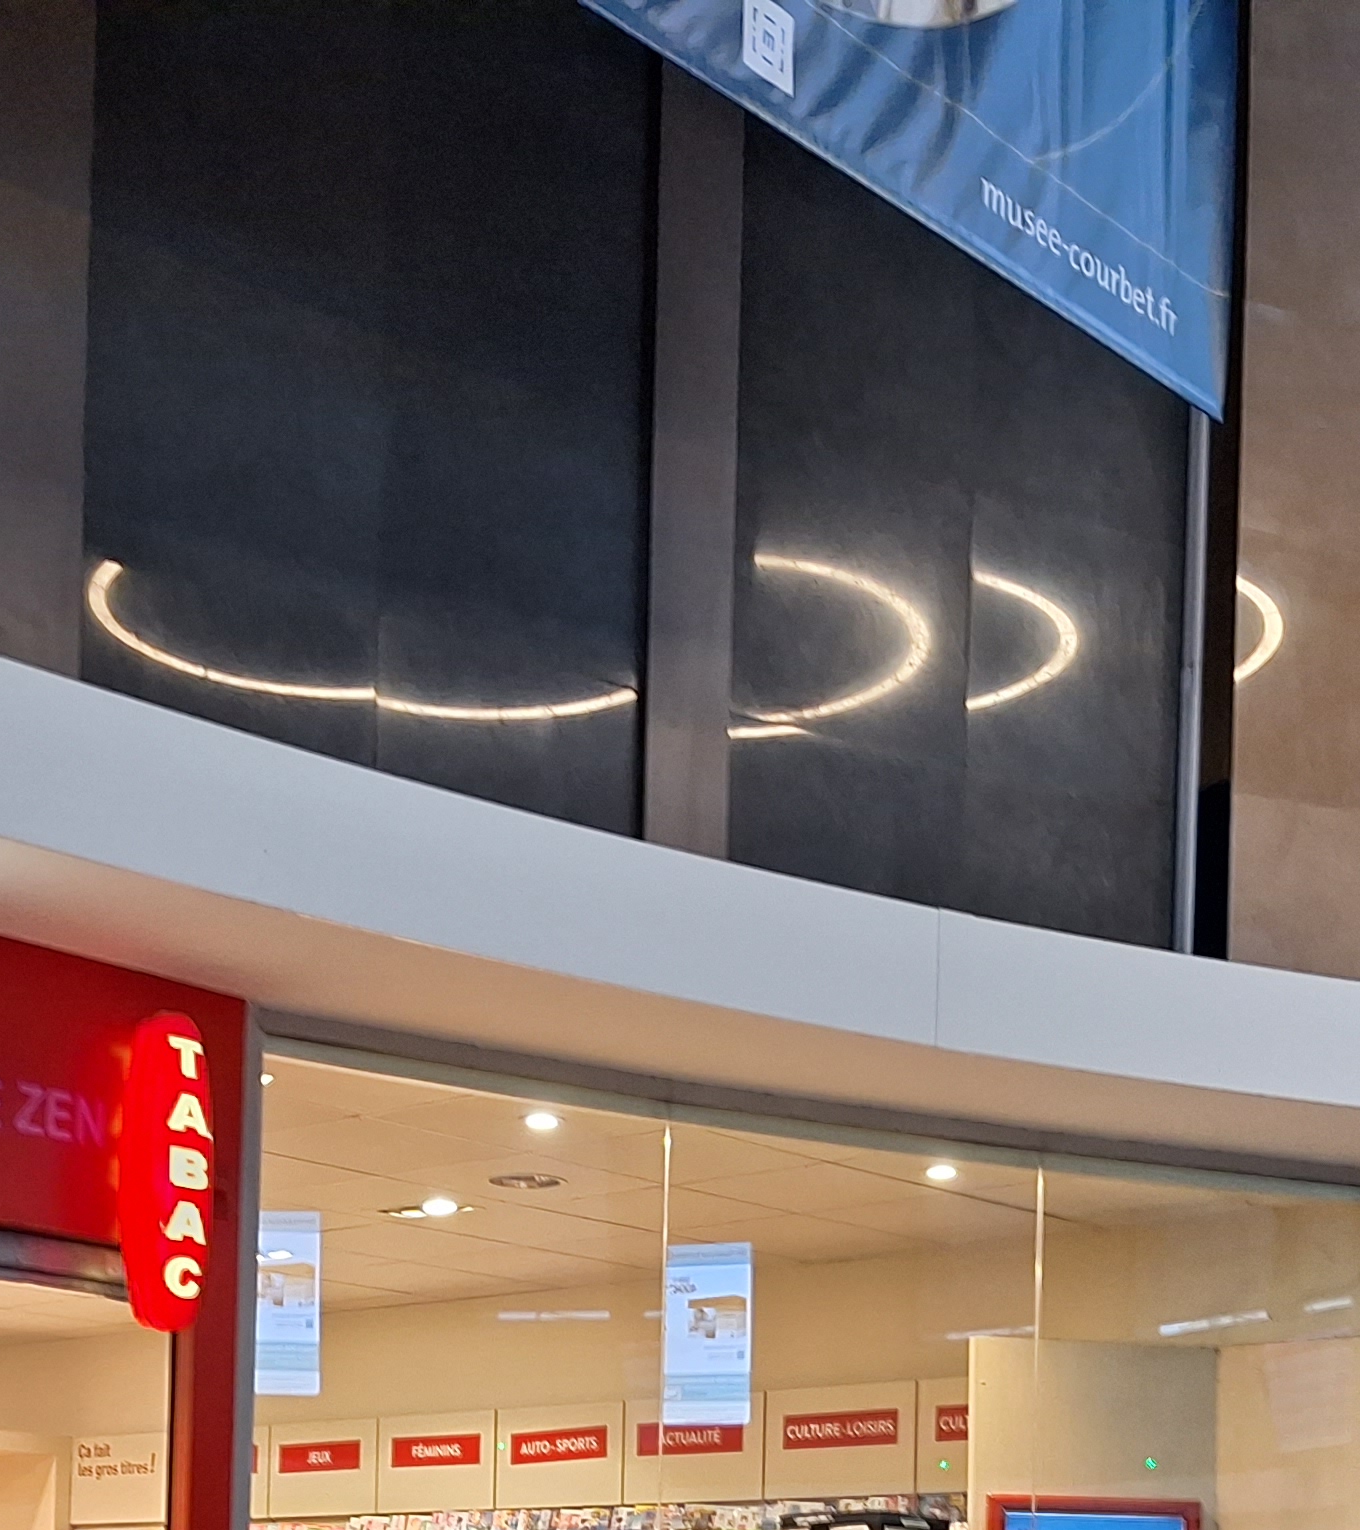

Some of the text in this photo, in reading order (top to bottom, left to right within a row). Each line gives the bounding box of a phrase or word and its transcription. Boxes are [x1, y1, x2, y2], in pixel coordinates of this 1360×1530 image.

[980, 176, 1178, 337] musee-courbet.fr
[13, 1078, 107, 1147] ZEN
[160, 1034, 214, 1300] TABAC
[306, 1450, 334, 1466] JEUX
[411, 1441, 463, 1459] FÉMININS
